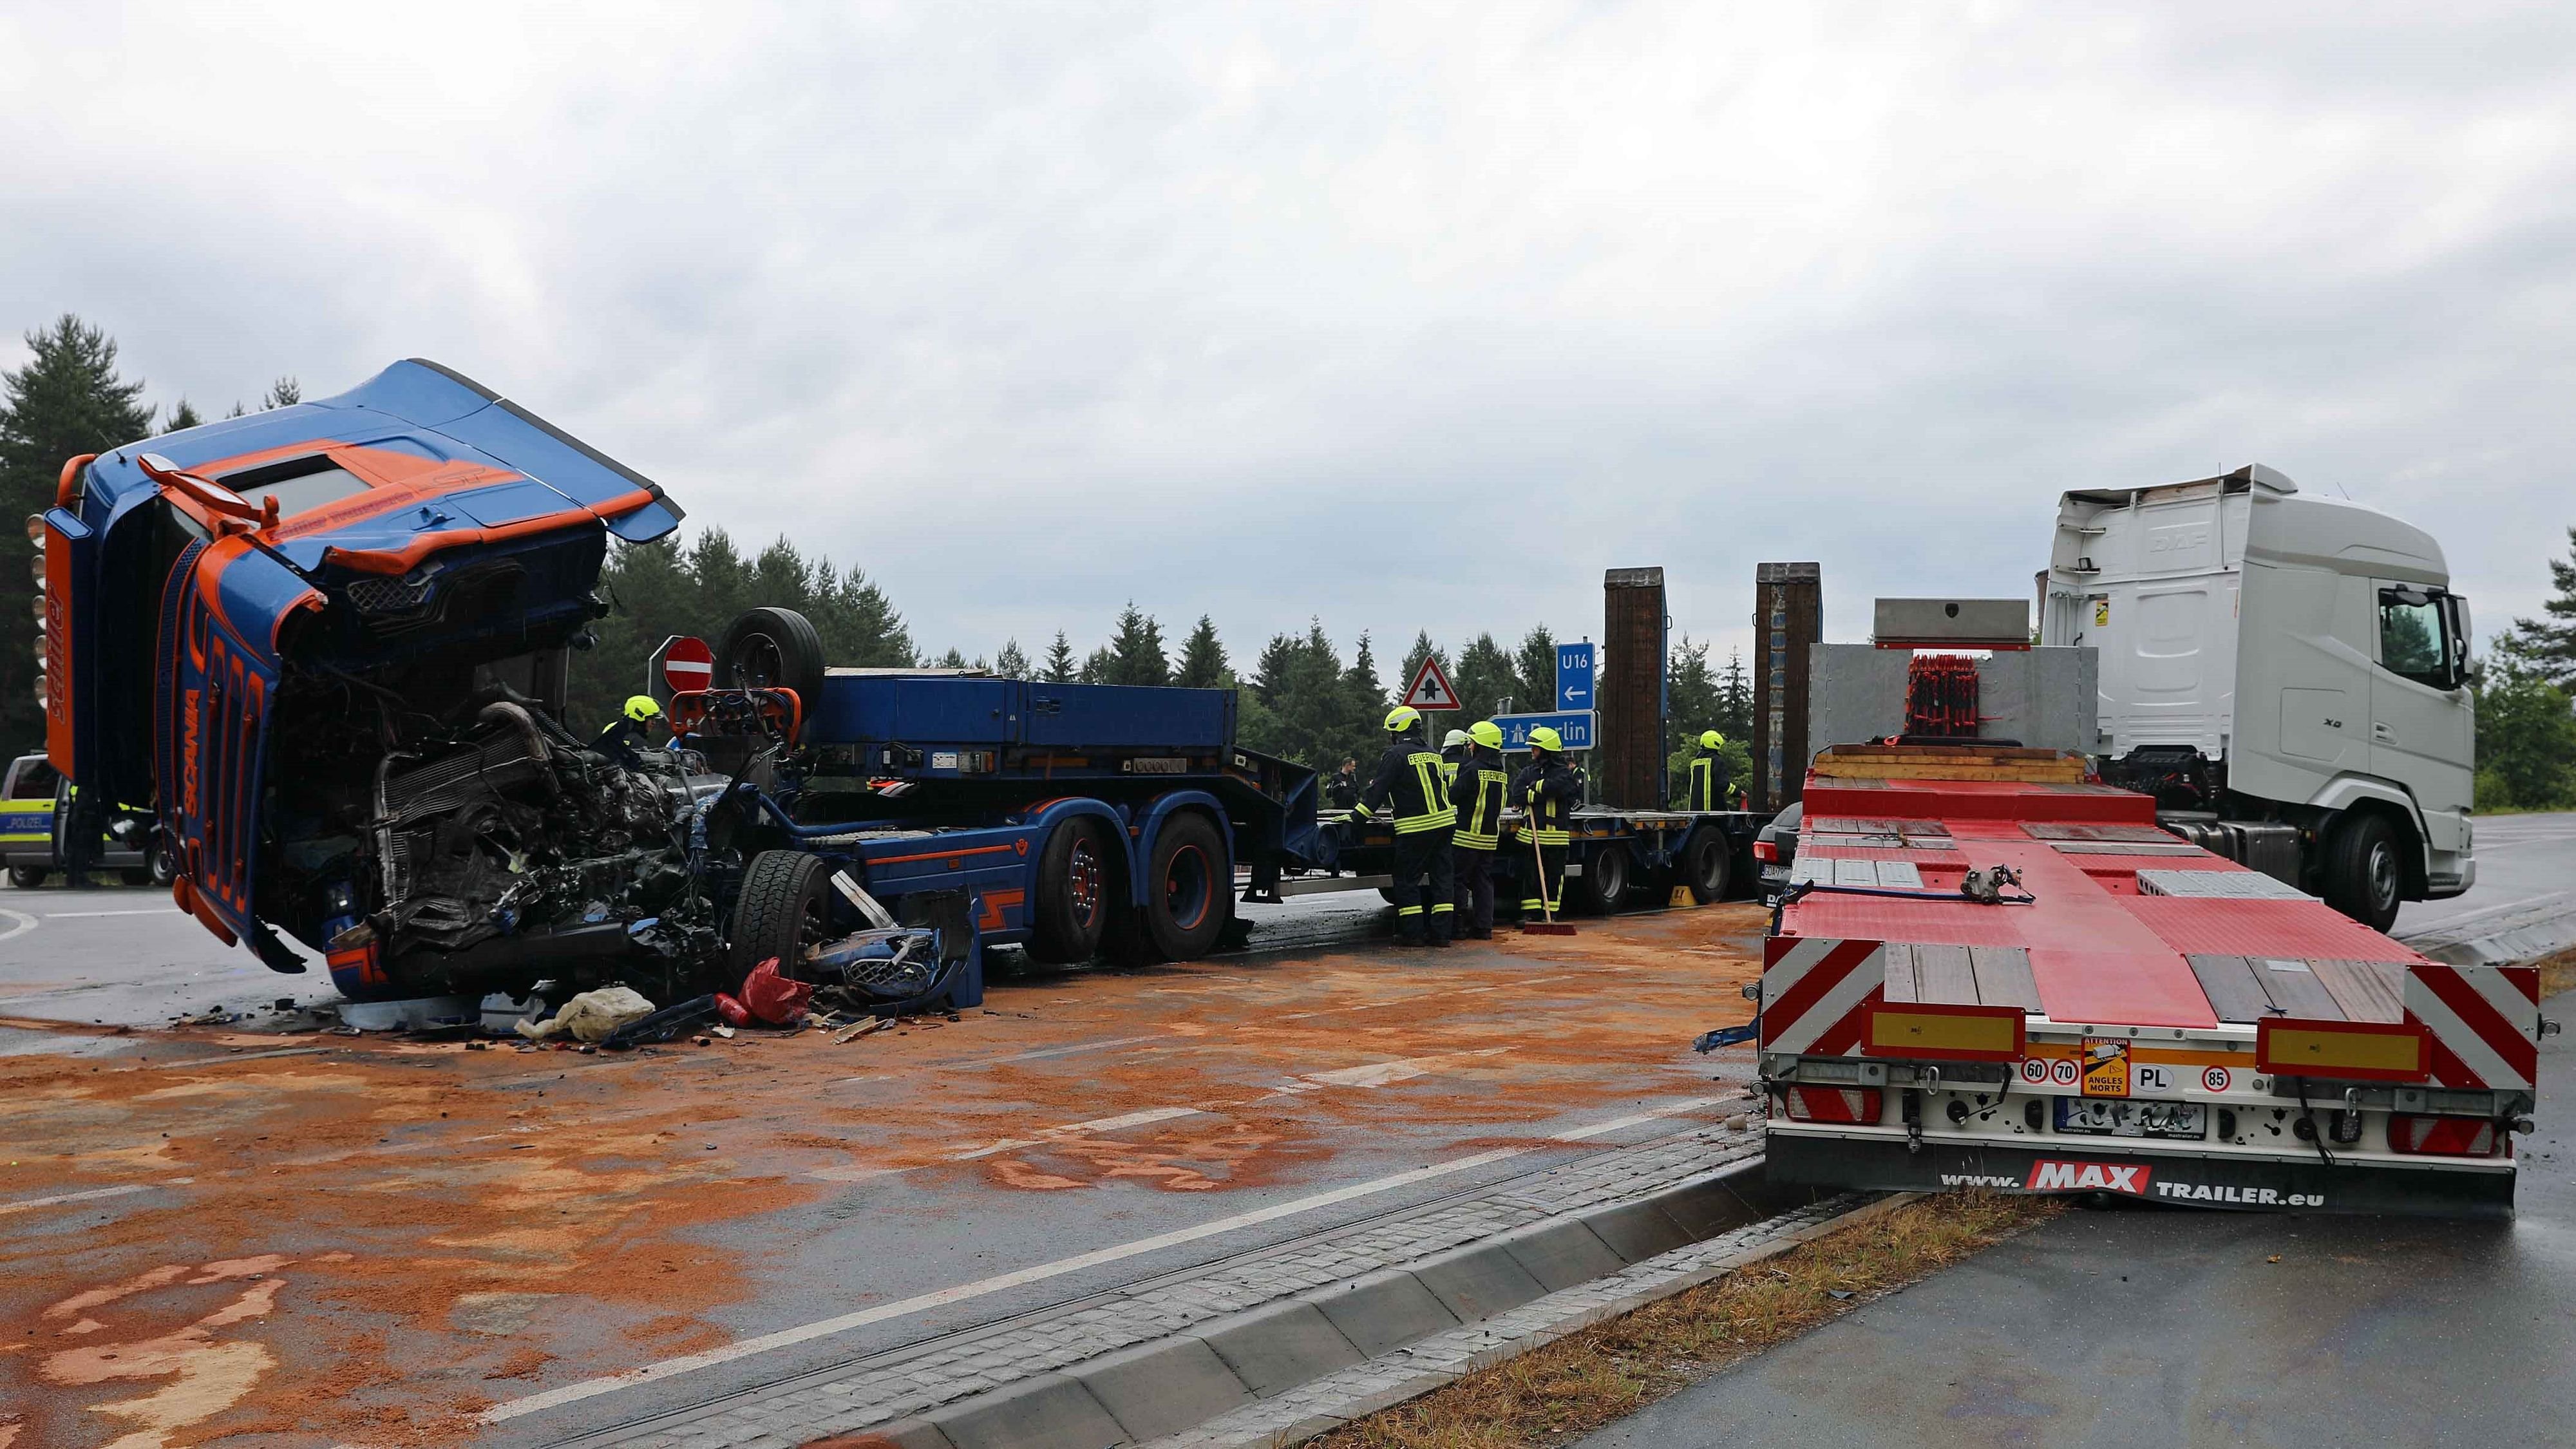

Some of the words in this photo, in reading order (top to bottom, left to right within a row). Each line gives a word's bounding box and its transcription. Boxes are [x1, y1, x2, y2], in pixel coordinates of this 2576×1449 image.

[2150, 533, 2208, 553] DAF
[184, 689, 201, 819] SCANIA
[2027, 1063, 2043, 1077] 60
[2057, 1065, 2073, 1079] 70
[2140, 1068, 2167, 1088] PL
[2088, 1076, 2123, 1084] ANGLES
[2208, 1072, 2224, 1086] 85
[1940, 1174, 2020, 1188] www.
[2034, 1162, 2139, 1194] MAX
[2156, 1181, 2325, 1207] TRAILER.eu
